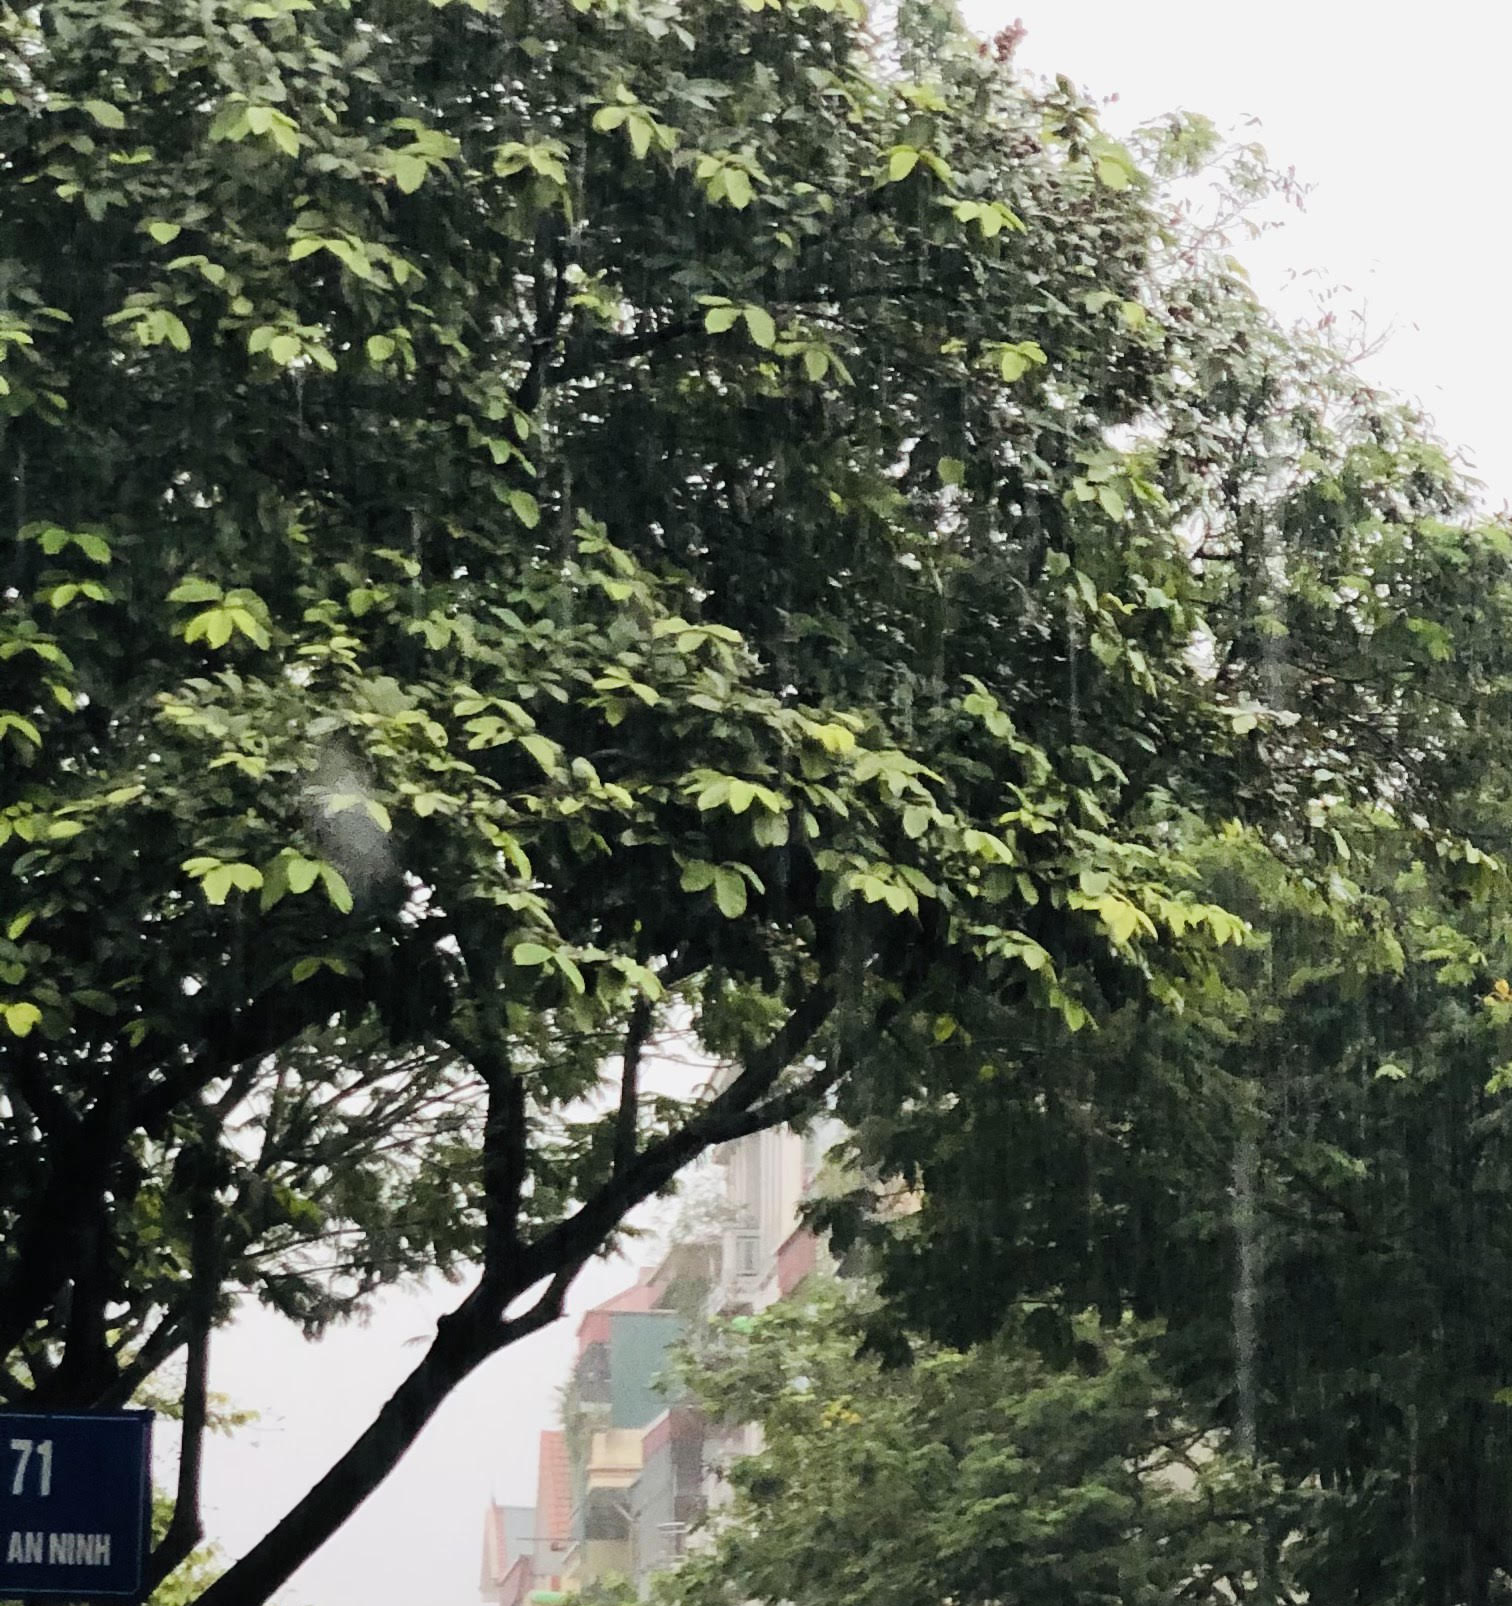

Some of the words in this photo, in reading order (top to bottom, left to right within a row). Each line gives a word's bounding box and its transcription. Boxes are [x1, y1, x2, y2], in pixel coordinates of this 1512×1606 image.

[11, 1438, 53, 1496] 71
[7, 1531, 44, 1564] AN
[49, 1532, 111, 1566] NINH
